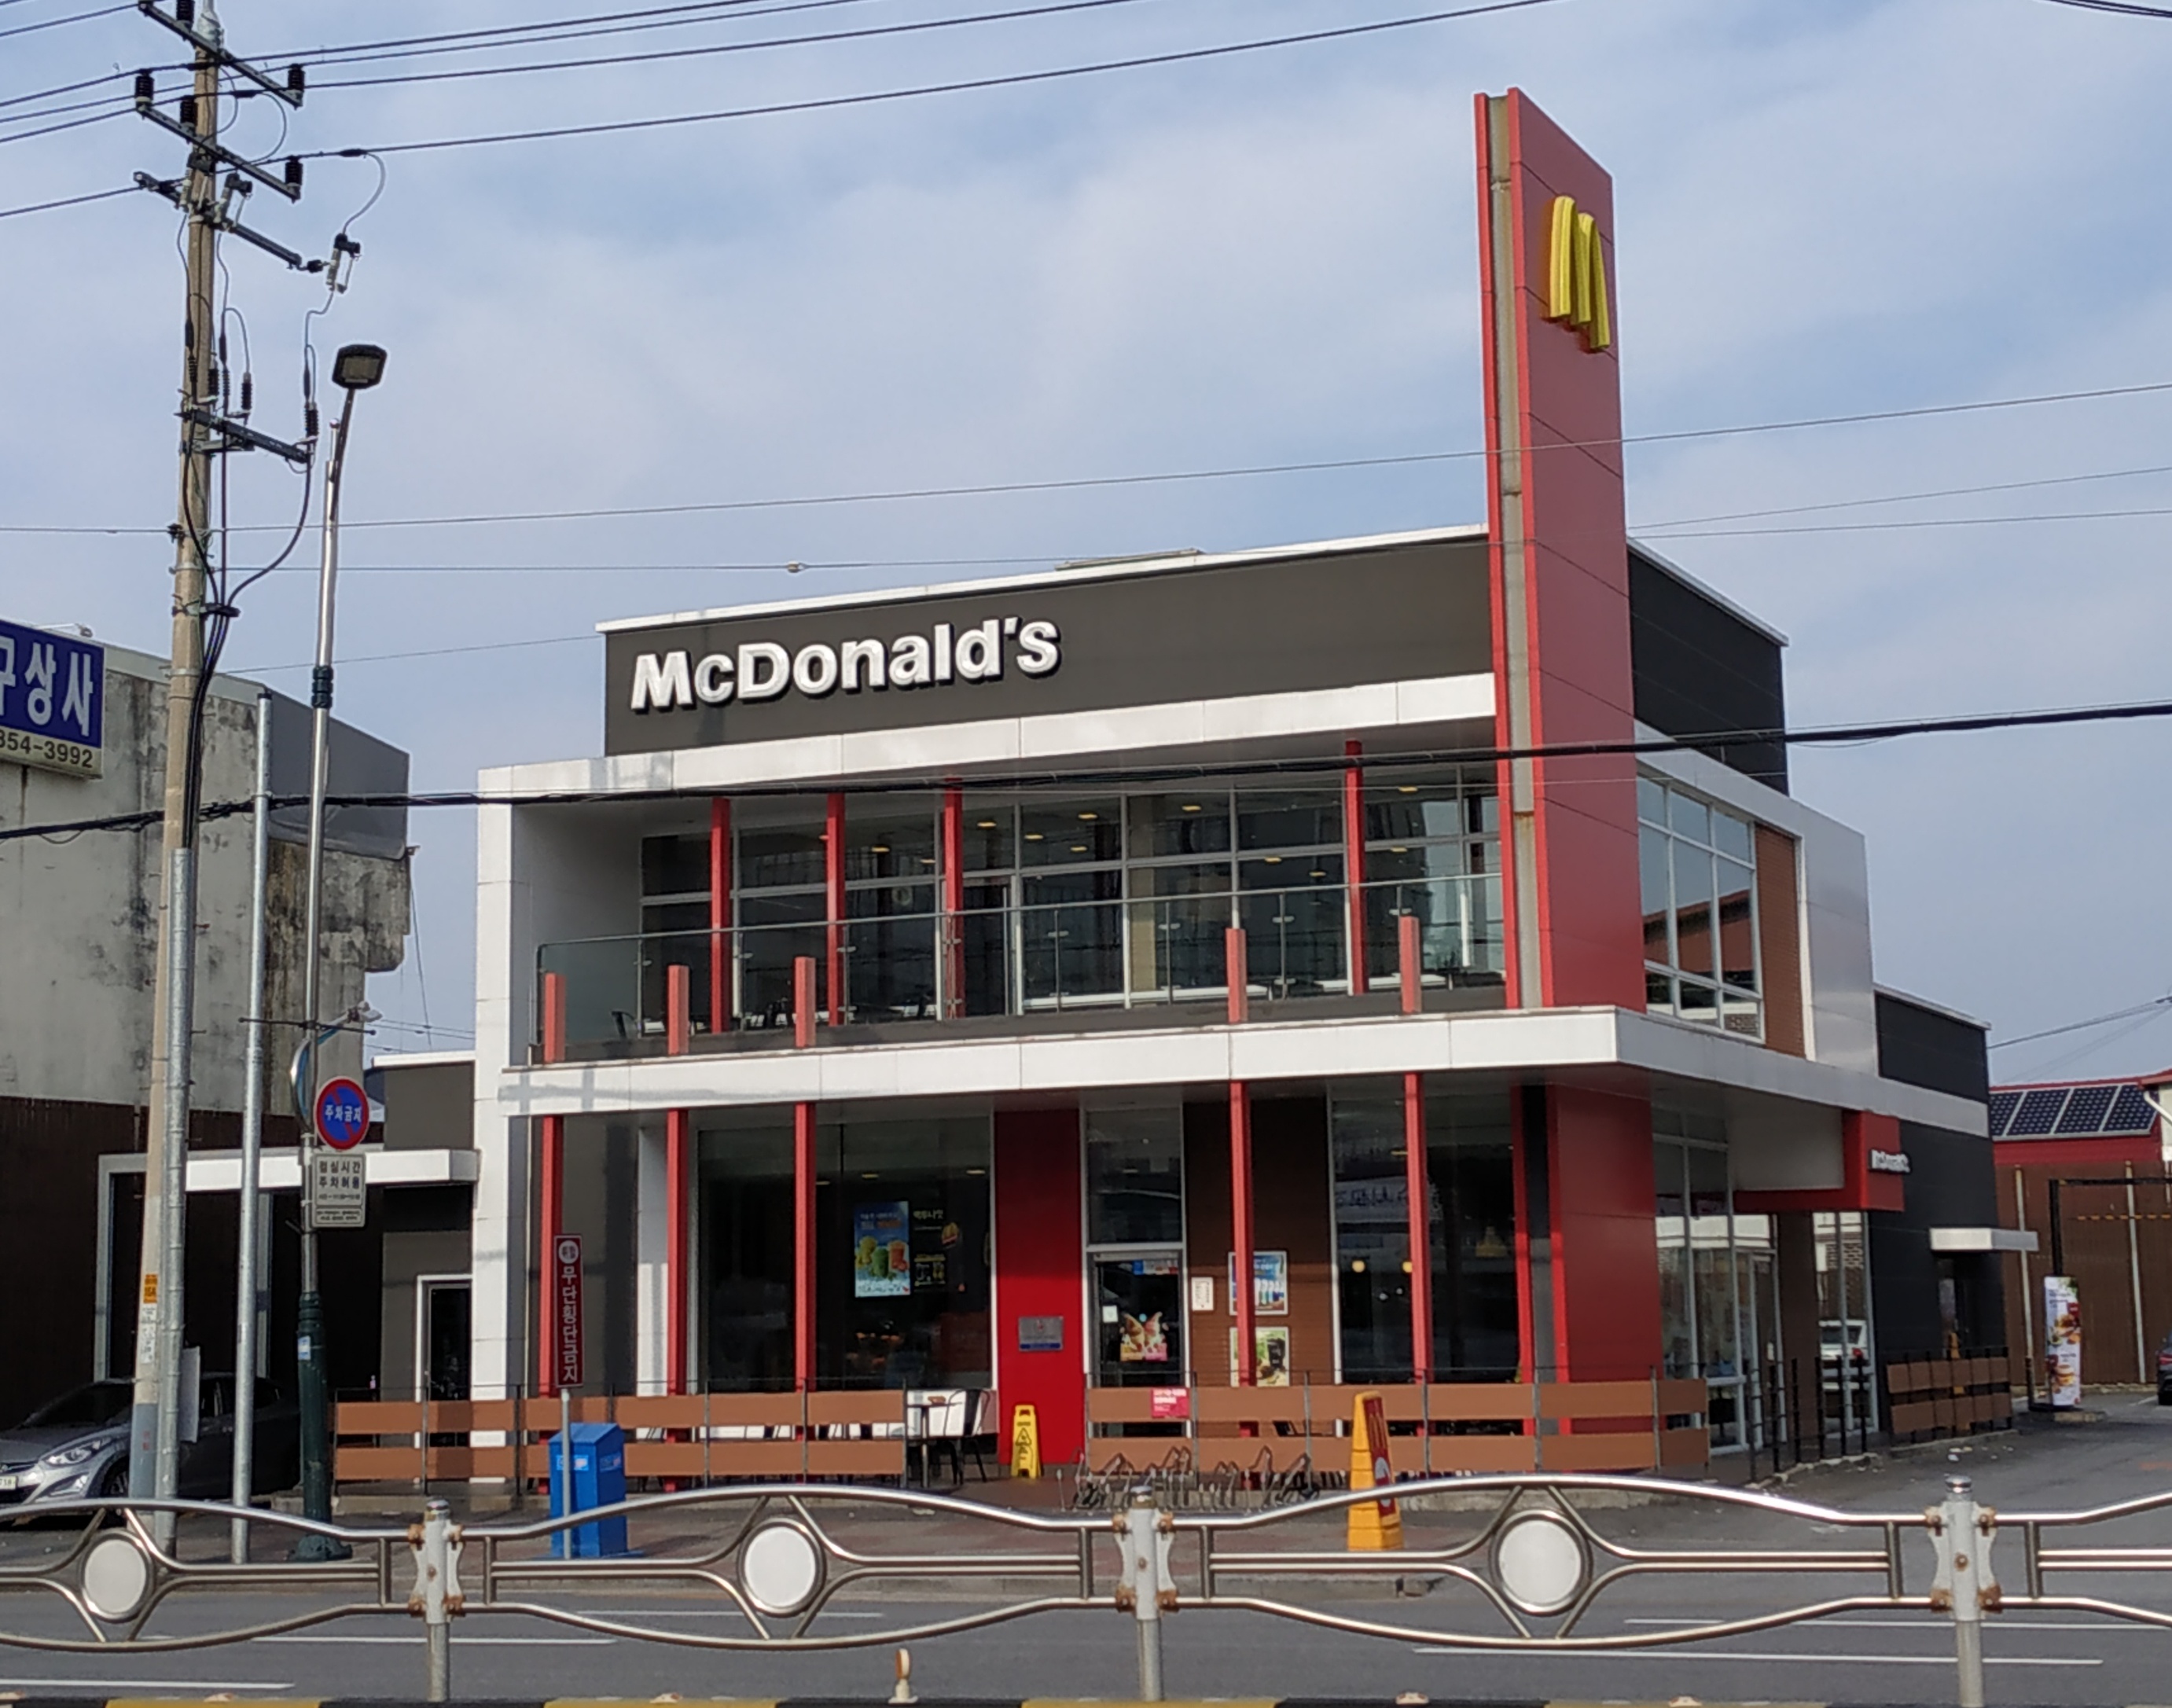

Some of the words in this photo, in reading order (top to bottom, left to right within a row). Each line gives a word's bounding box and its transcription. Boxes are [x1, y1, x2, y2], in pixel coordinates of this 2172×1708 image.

[630, 617, 1059, 710] McDonald's
[325, 1104, 362, 1122] 주차금지
[561, 1265, 579, 1383] 무단횡단금지
